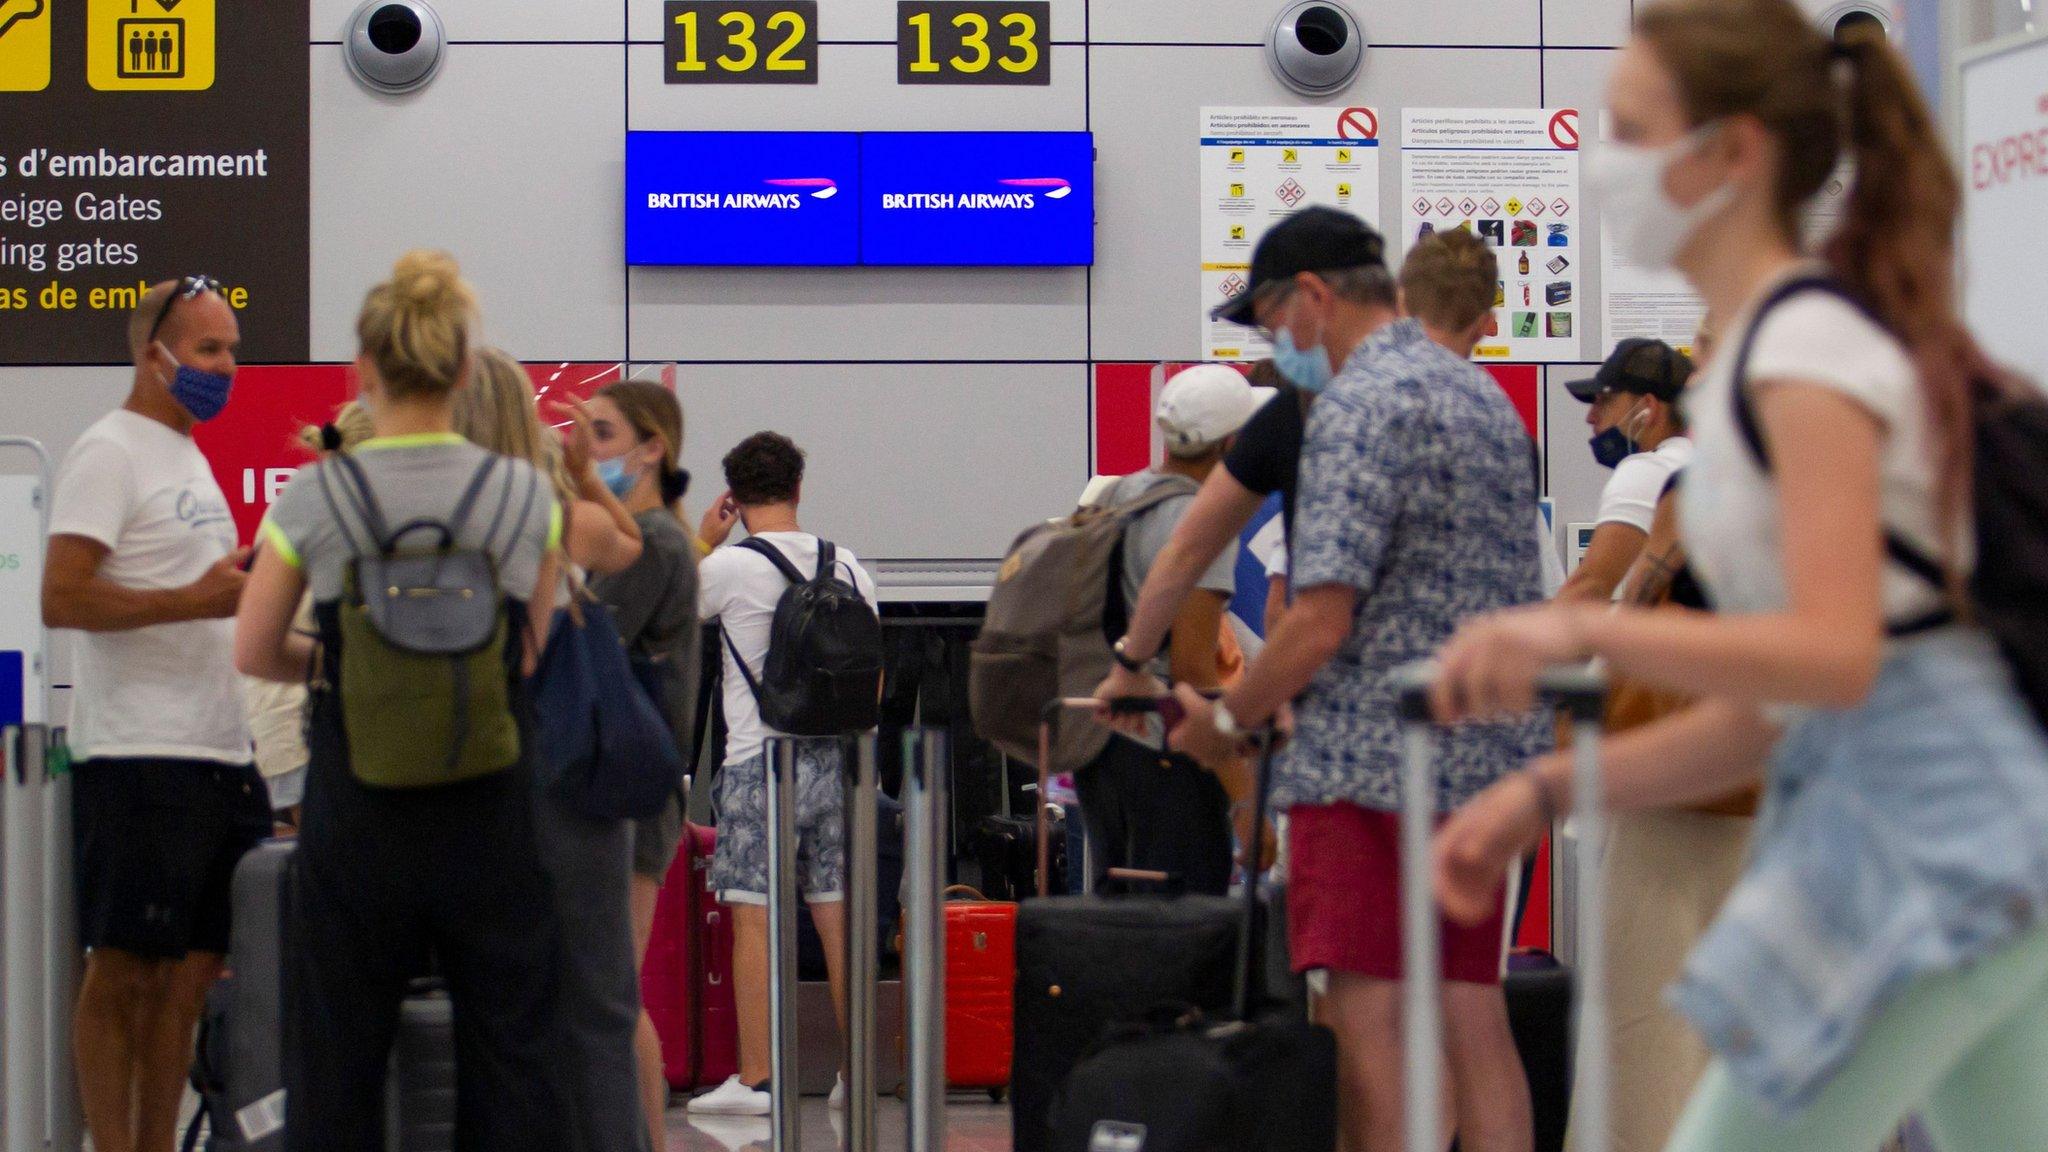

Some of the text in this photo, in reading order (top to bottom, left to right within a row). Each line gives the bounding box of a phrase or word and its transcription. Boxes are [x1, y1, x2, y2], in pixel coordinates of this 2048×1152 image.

[674, 11, 807, 72] 132
[908, 12, 1039, 73] 133
[0, 192, 163, 227] eige Gates
[647, 193, 801, 209] BRITISH AIRWAYS
[882, 193, 1035, 209] BRITISH AIRWAYS
[57, 237, 139, 272] gates
[39, 281, 78, 310] de
